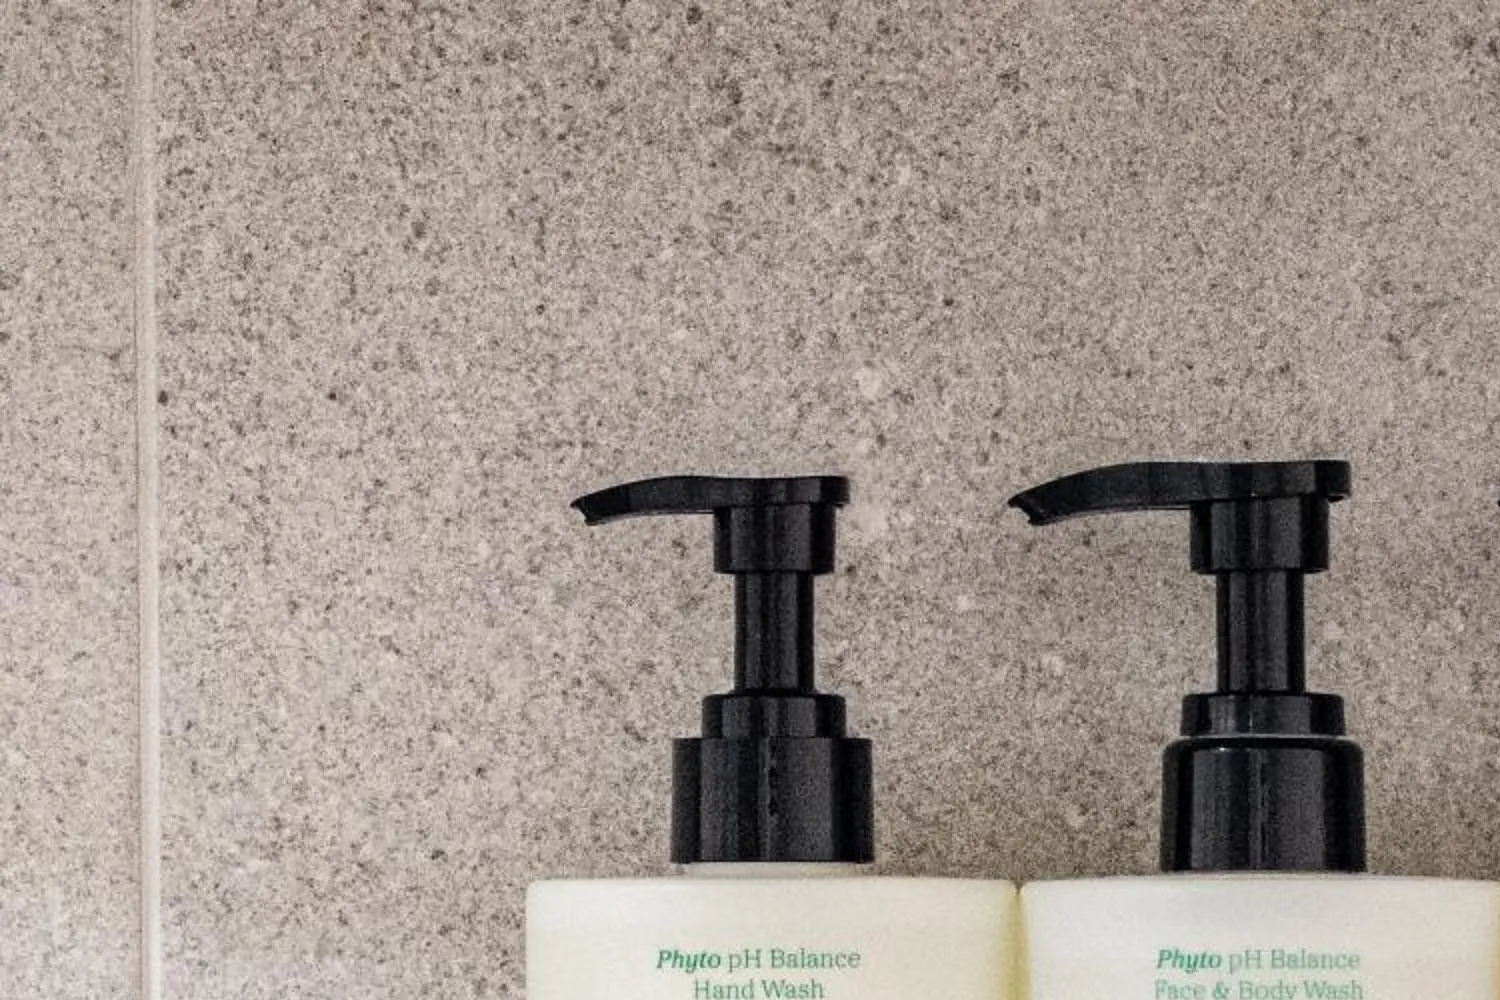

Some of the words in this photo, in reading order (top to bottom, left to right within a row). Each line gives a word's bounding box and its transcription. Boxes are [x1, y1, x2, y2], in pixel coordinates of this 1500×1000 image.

[656, 947, 722, 974] Phyto
[727, 947, 763, 974] pH
[769, 947, 862, 970] Balance
[1155, 947, 1223, 975] Phyto
[1228, 947, 1265, 976] pH
[1270, 947, 1362, 970] Balance
[692, 979, 755, 1000] Hand
[760, 979, 825, 1000] Wash
